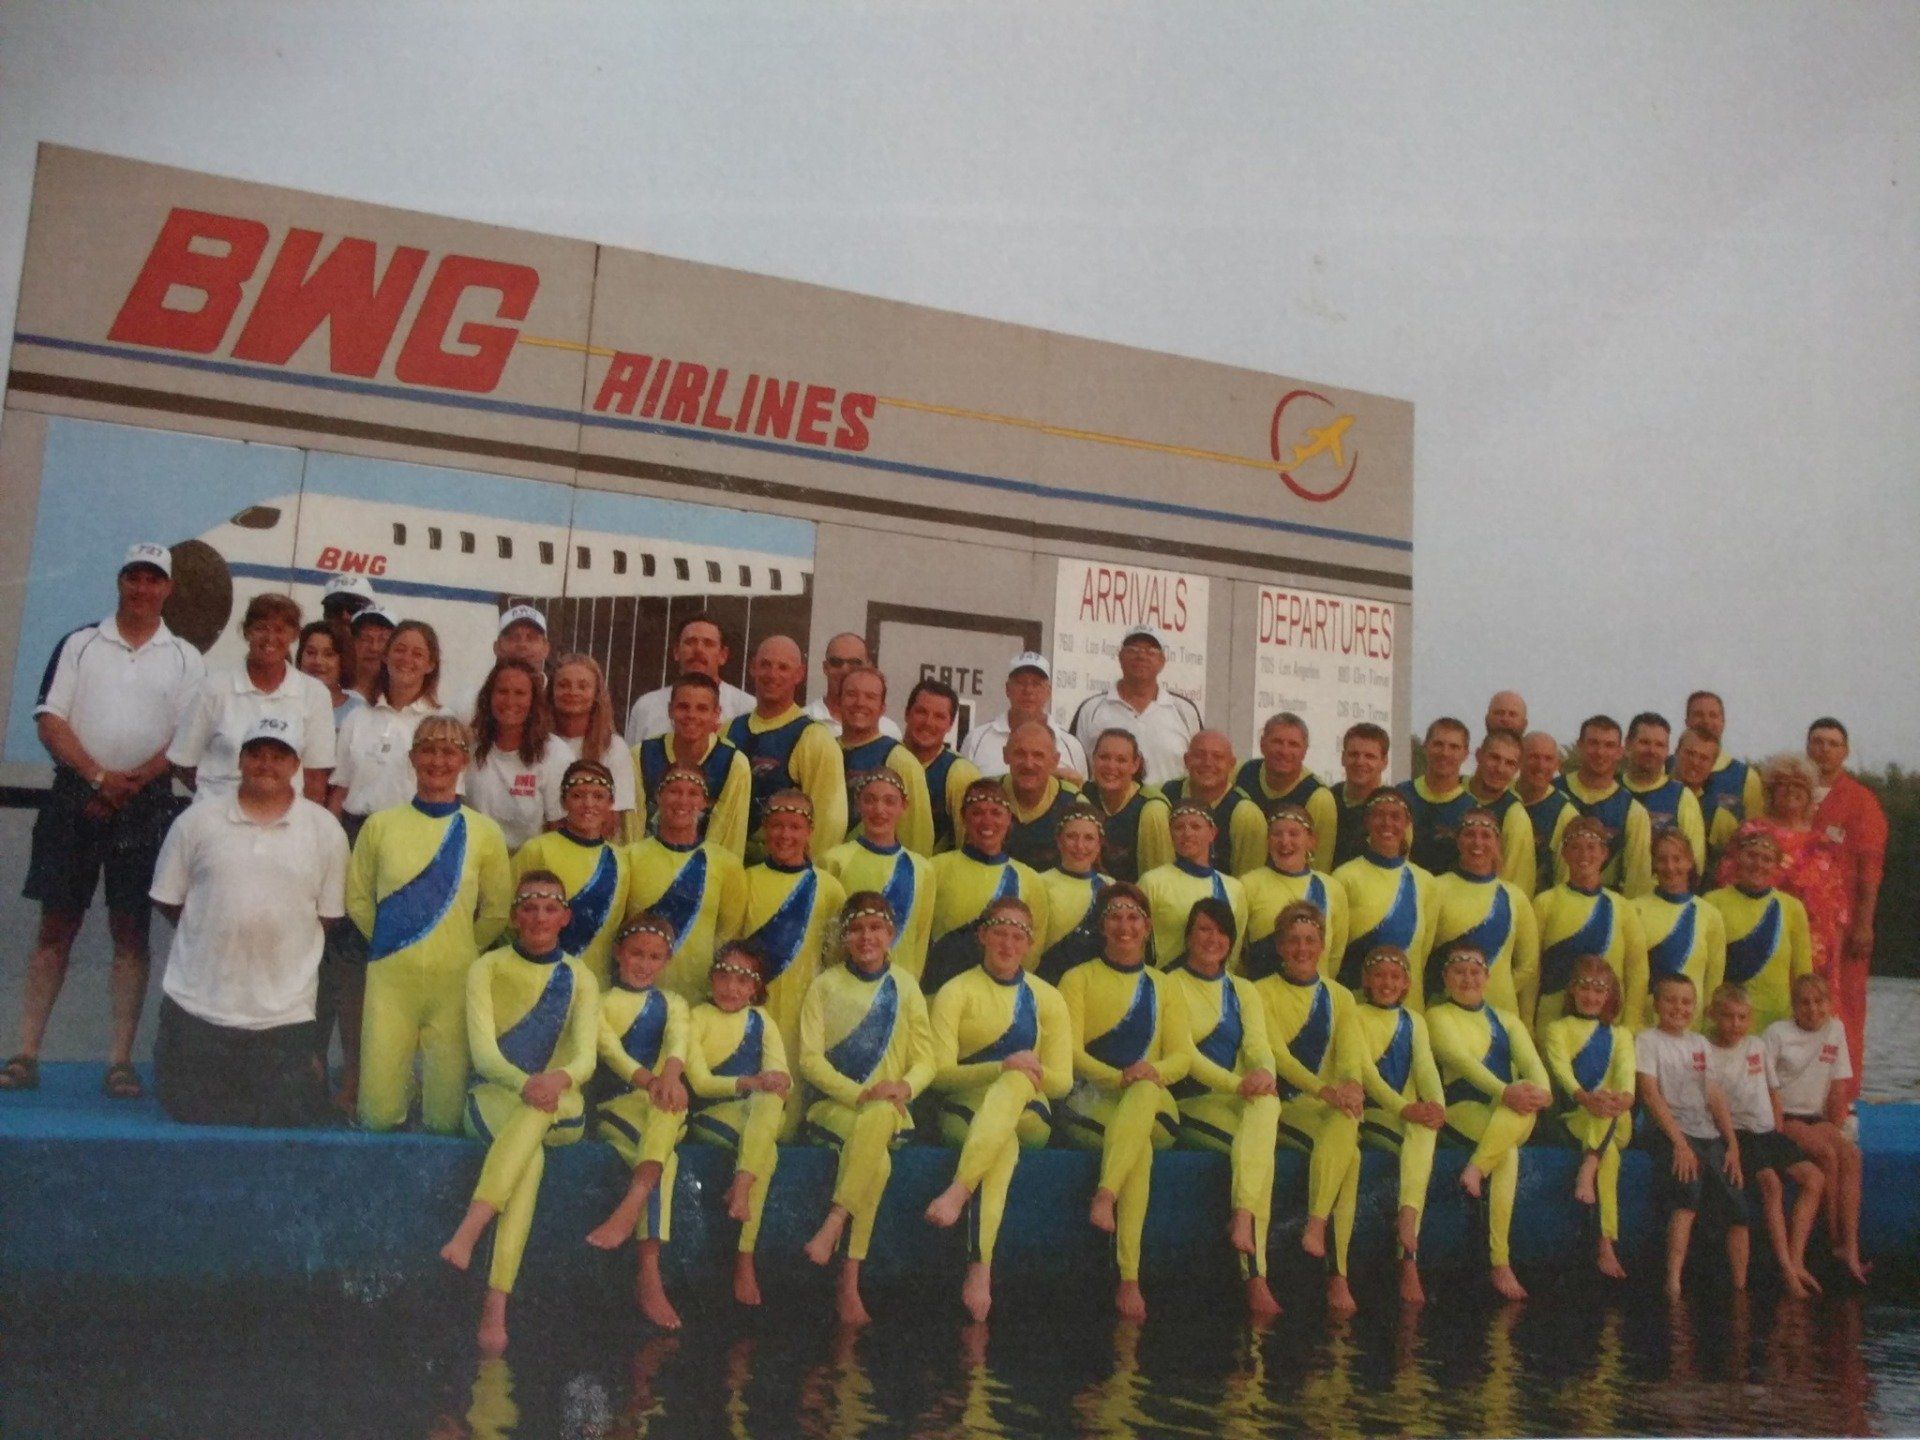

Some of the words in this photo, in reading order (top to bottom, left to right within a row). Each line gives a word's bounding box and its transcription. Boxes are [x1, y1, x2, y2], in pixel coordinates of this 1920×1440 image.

[107, 207, 540, 393] BWG
[593, 350, 879, 452] AIRLINES
[316, 547, 387, 575] BWG
[1080, 567, 1187, 632] ARRIVALS
[1259, 591, 1392, 660] DEPARTURES
[919, 663, 984, 695] GATE
[1179, 646, 1204, 666] Time
